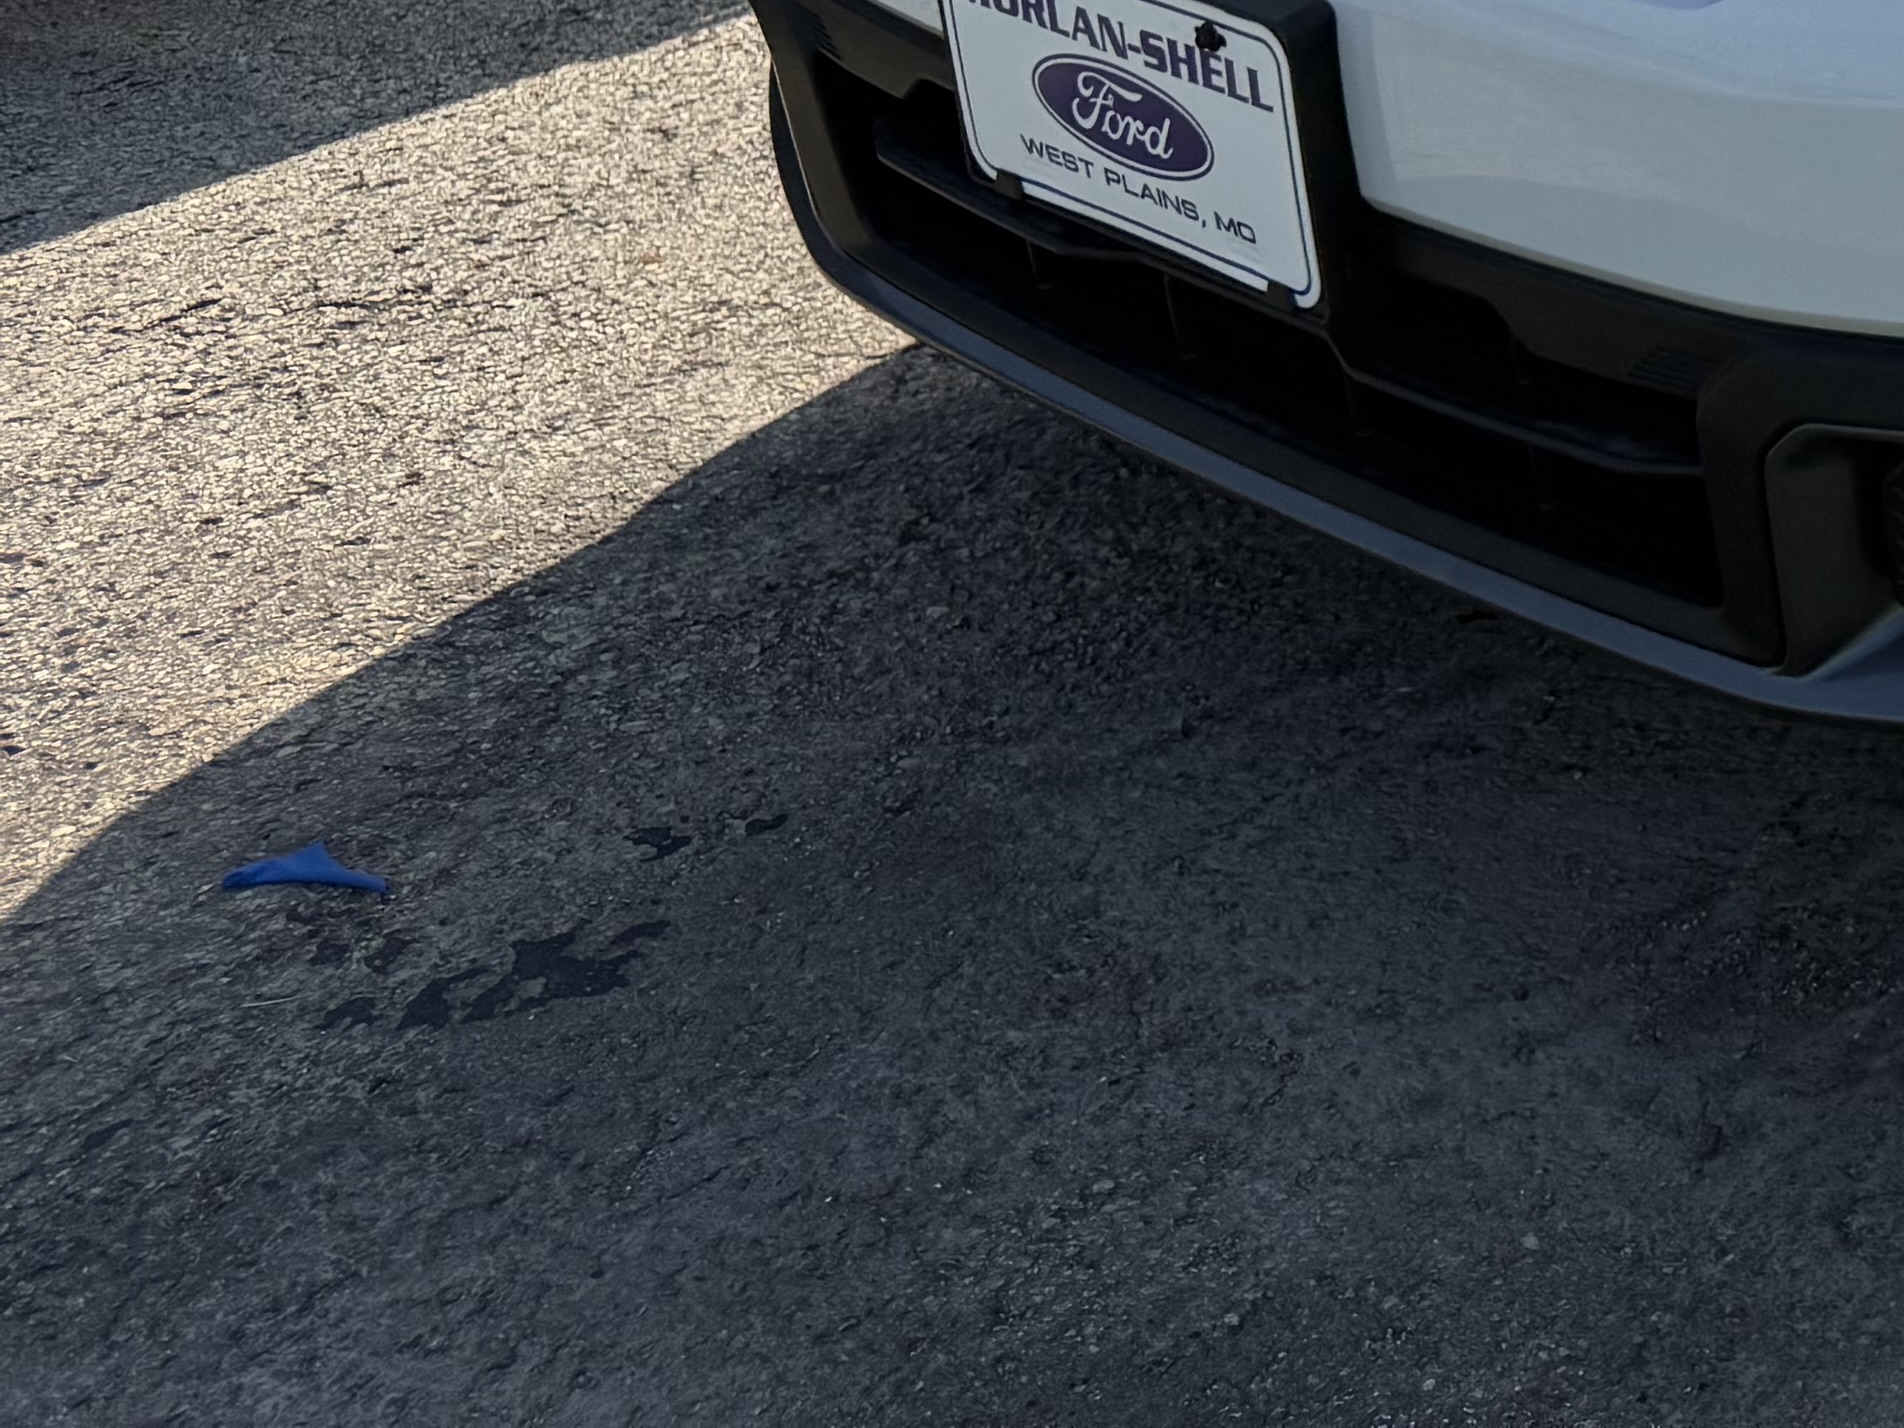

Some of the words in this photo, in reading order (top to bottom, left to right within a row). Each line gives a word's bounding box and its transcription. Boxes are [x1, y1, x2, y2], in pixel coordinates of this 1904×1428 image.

[1072, 70, 1174, 160] Ford
[1020, 133, 1094, 178] WEST
[1103, 166, 1208, 229] PLAINS,
[1214, 210, 1257, 245] MO
